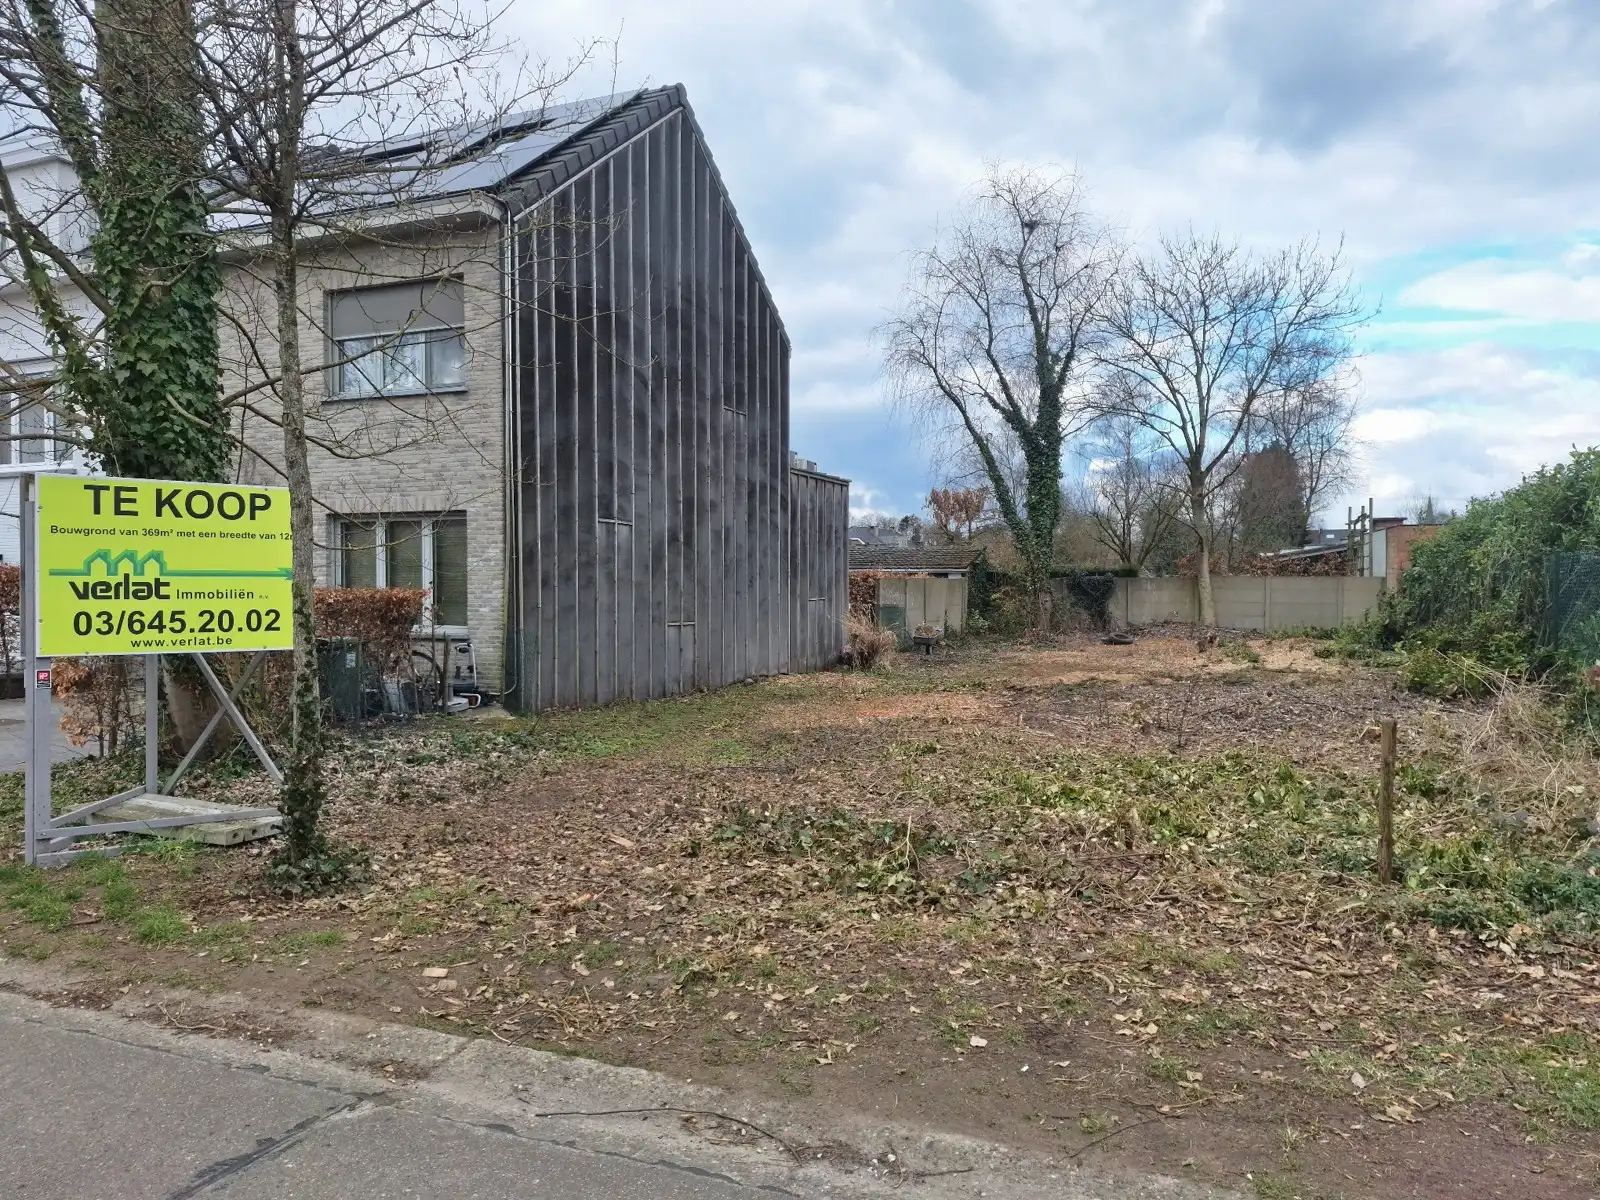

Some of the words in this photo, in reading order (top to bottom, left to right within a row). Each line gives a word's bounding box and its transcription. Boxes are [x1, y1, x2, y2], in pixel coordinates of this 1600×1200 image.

[84, 484, 139, 516] TE
[155, 488, 272, 520] KOOP
[50, 525, 116, 537] Bouwgrond
[119, 528, 138, 536] van
[176, 530, 195, 538] met
[219, 531, 257, 539] breedte
[69, 573, 171, 600] verlat
[176, 589, 254, 599] Immobiliën
[73, 609, 281, 636] 03/645.20.02
[131, 636, 233, 648] www.verlat.be
